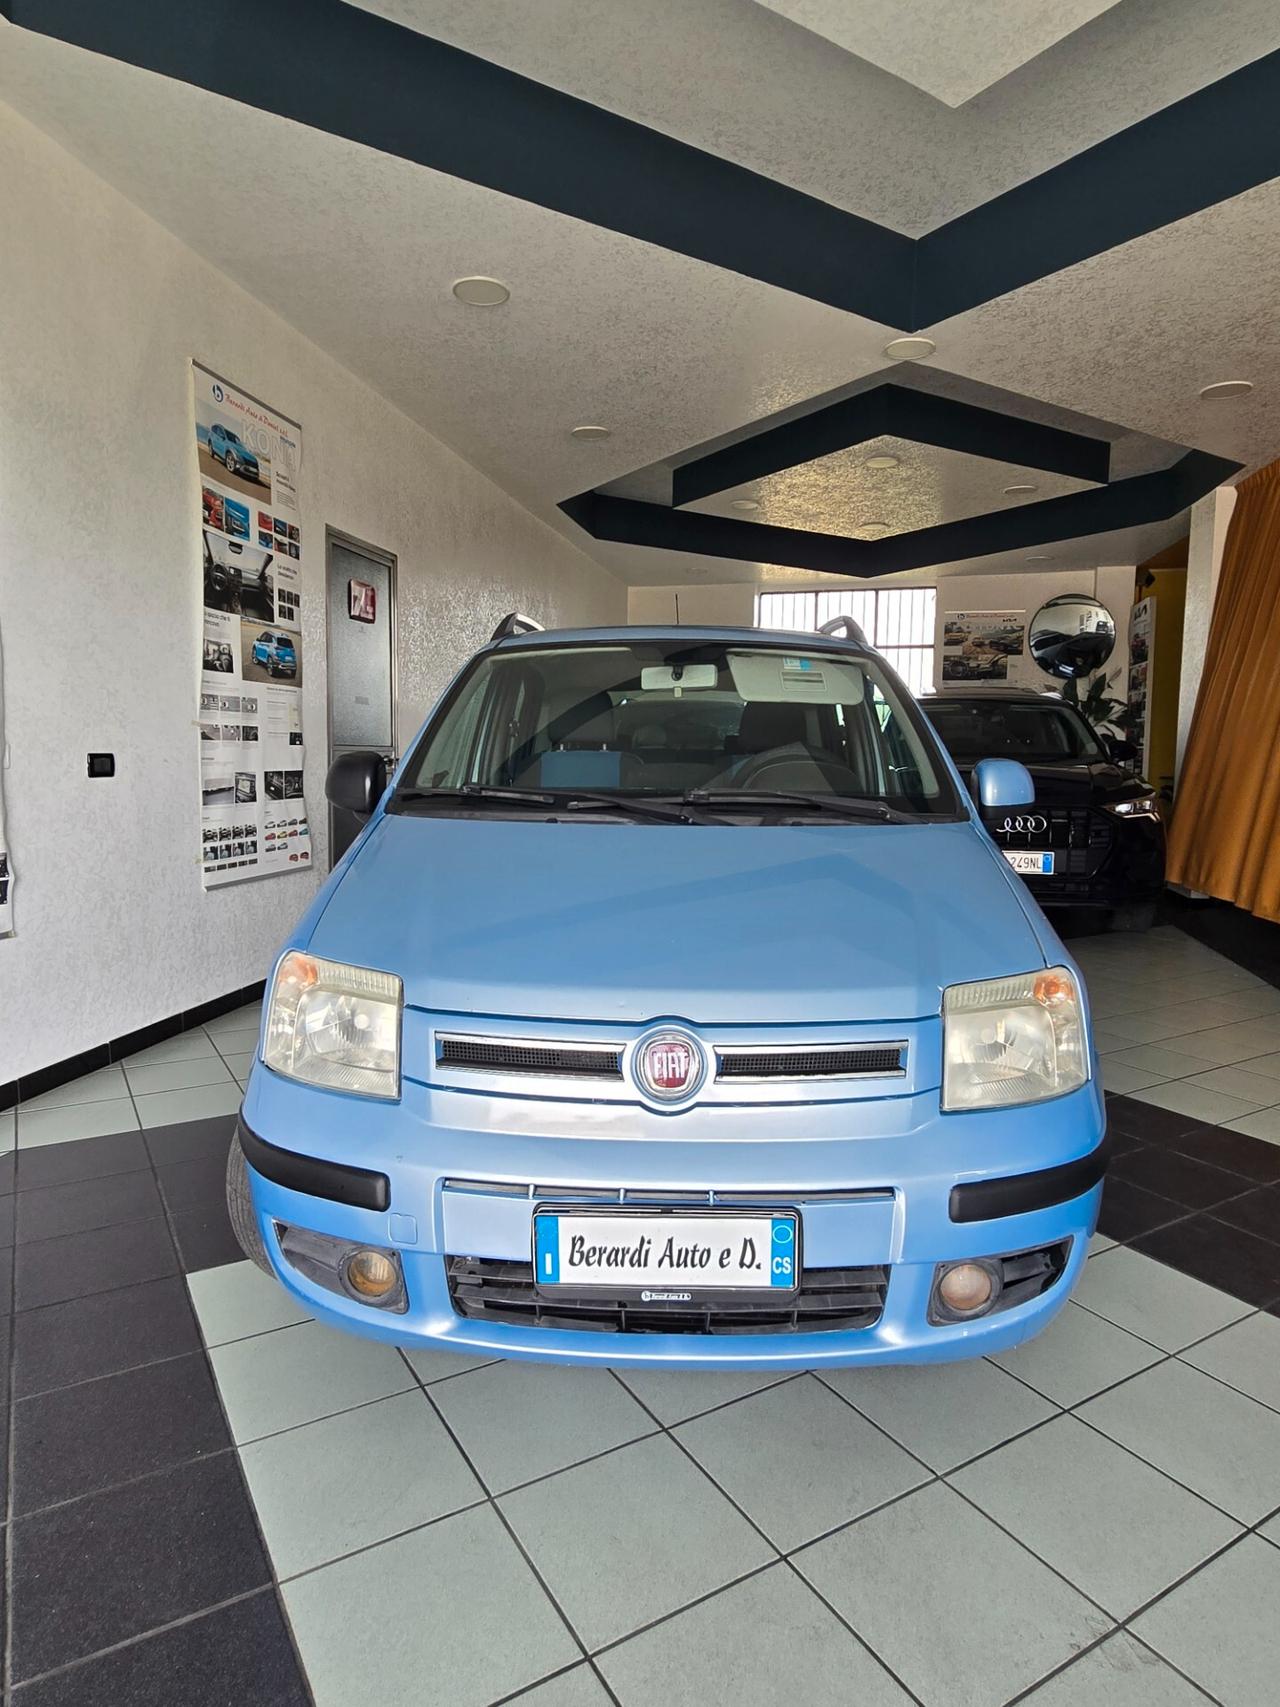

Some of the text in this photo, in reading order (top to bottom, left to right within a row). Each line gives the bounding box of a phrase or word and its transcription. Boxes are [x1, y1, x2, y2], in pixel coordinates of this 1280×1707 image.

[653, 1051, 688, 1078] FIAT
[568, 1234, 762, 1270] Berardi Auto e D.
[772, 1257, 792, 1275] CS
